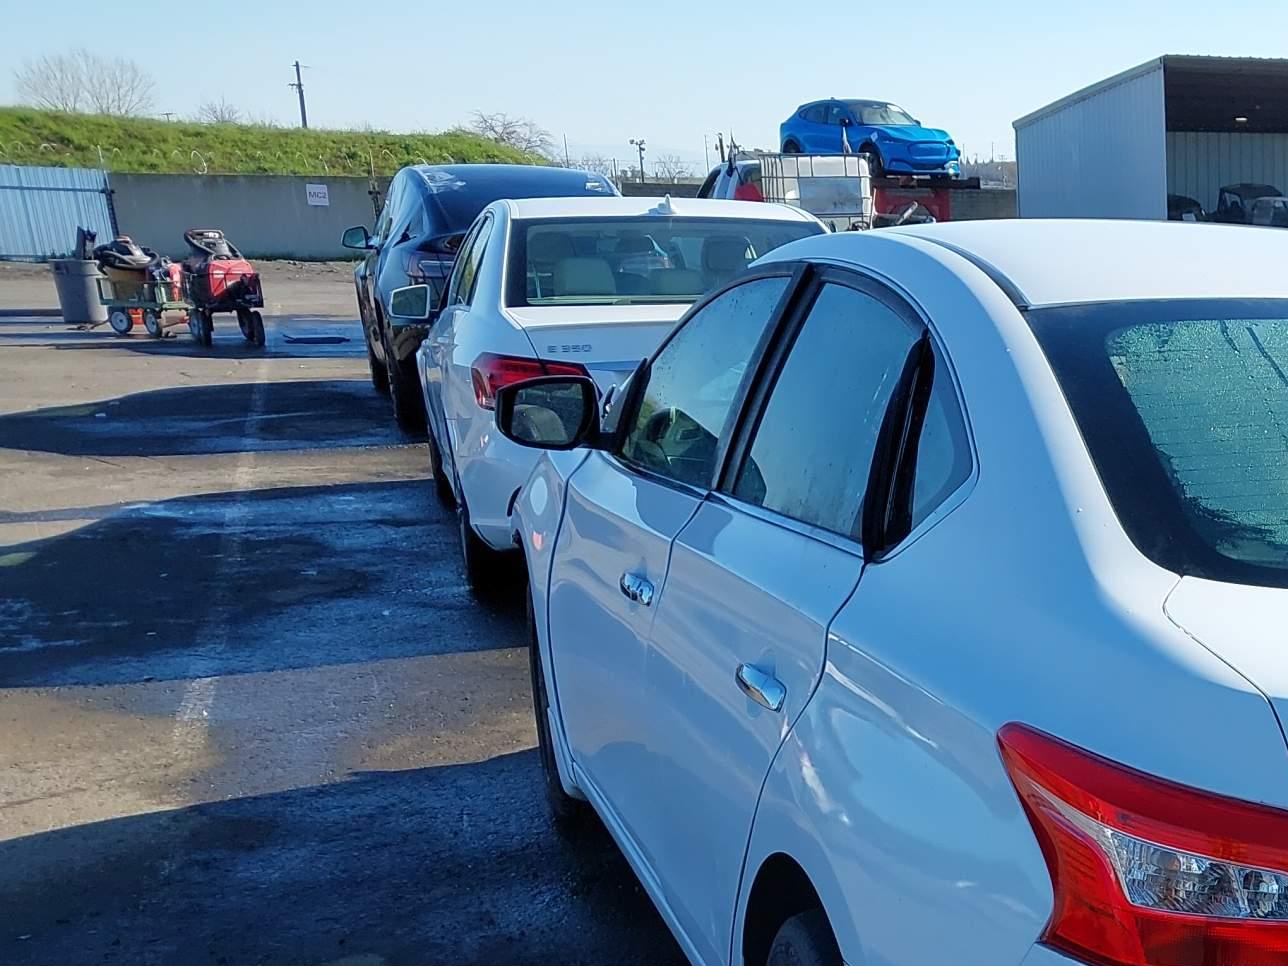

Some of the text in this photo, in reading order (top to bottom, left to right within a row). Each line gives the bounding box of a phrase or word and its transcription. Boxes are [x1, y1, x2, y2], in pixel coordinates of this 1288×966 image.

[308, 191, 327, 199] MC2
[547, 344, 592, 353] E 350
